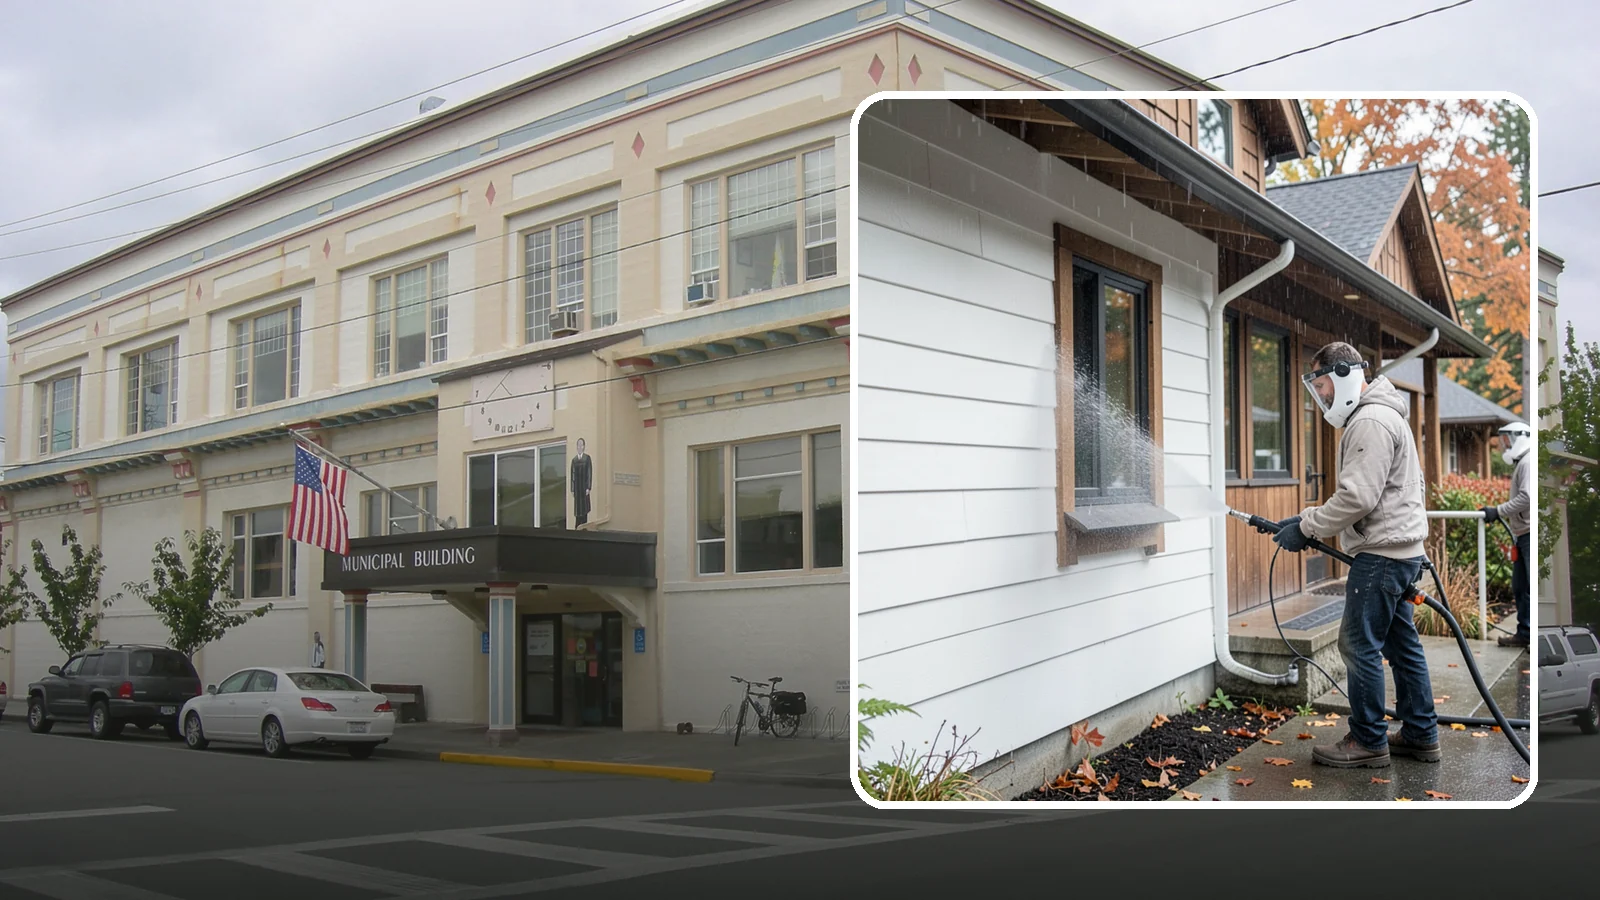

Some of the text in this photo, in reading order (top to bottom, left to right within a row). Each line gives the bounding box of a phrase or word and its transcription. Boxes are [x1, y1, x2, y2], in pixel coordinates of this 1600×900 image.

[480, 407, 485, 415] 8
[488, 418, 492, 426] 9
[507, 425, 513, 433] 12
[521, 420, 525, 428] 2
[529, 414, 533, 422] 3
[536, 402, 540, 410] 4
[342, 546, 475, 571] MUNICIPAL BUILDING
